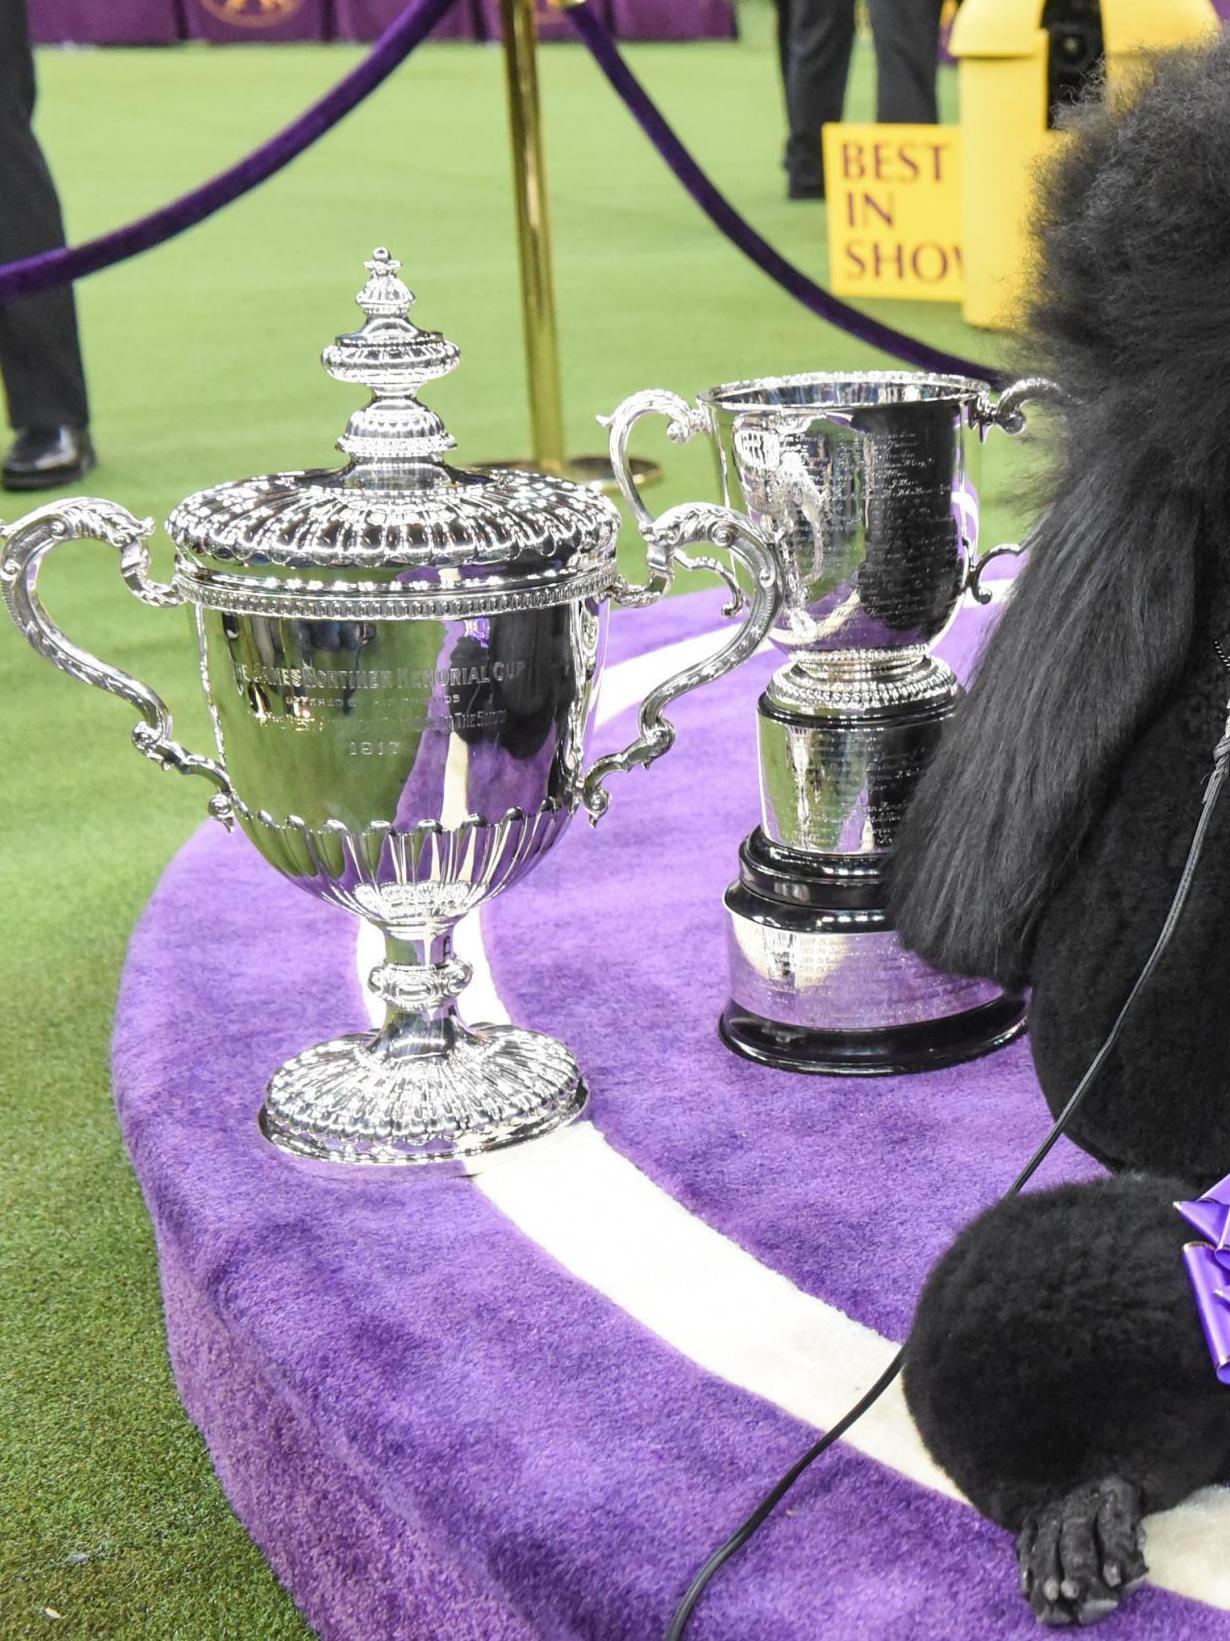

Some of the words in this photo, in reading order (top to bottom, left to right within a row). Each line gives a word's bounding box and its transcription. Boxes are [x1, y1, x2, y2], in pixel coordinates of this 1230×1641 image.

[842, 142, 948, 183] BEST
[846, 190, 895, 228] IN
[493, 661, 524, 682] CUP
